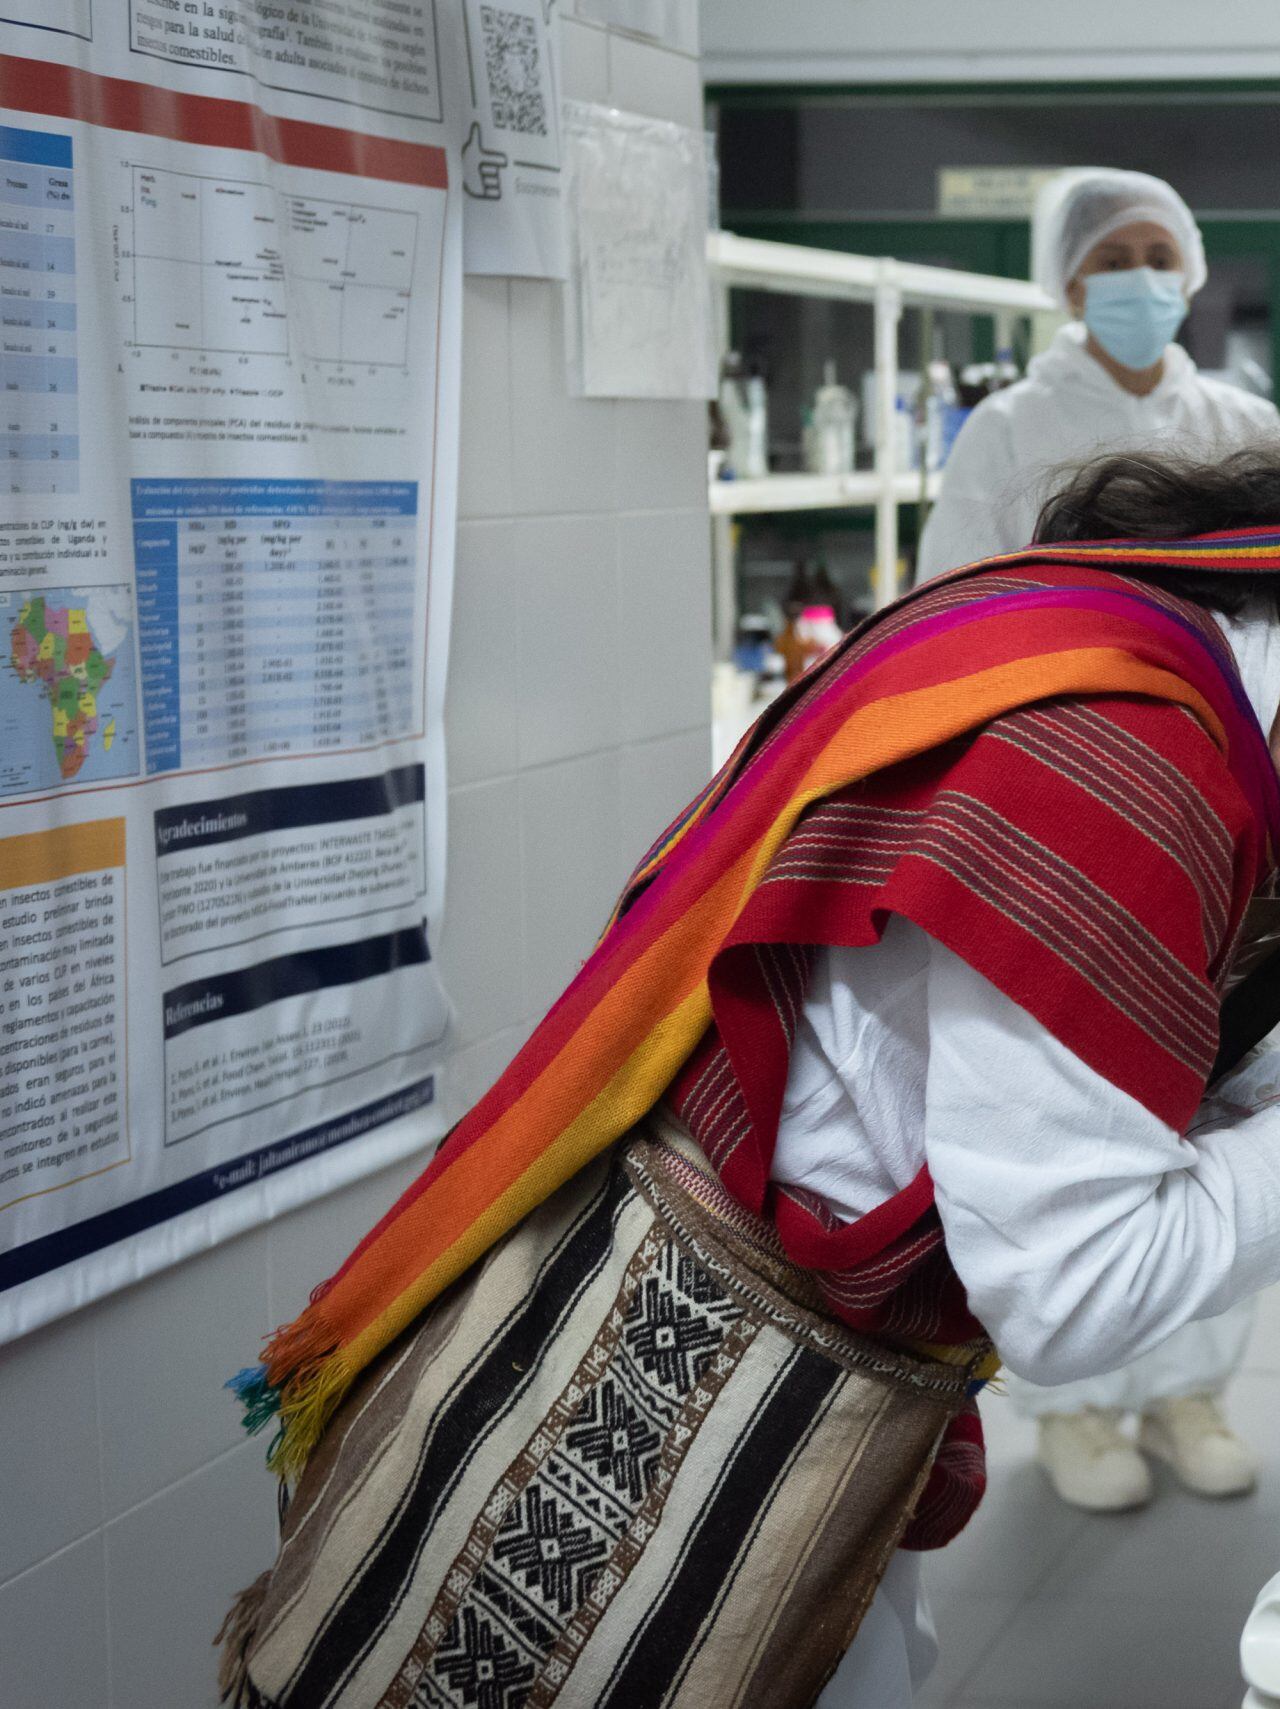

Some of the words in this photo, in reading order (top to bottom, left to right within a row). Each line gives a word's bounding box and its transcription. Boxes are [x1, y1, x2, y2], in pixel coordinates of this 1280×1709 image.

[184, 2, 198, 14] en
[203, 2, 214, 17] la
[164, 21, 185, 35] para
[189, 21, 199, 37] la
[203, 26, 235, 43] salud
[169, 44, 237, 65] comestibles.
[11, 888, 50, 907] insectos
[101, 873, 113, 887] de
[2, 911, 37, 930] estudio
[85, 894, 113, 910] brinda
[12, 930, 52, 948] insectos
[102, 914, 114, 927] de
[79, 933, 114, 951] limitada
[4, 978, 14, 992] de
[19, 972, 49, 988] varios
[85, 953, 114, 970] niveles
[9, 999, 20, 1012] en
[27, 993, 43, 1007] los
[73, 980, 86, 994] del
[165, 992, 225, 1026] Referencias
[2, 1009, 59, 1035] reglamentos
[104, 1011, 115, 1024] de
[4, 1052, 57, 1077] disponibles
[26, 1073, 50, 1090] eran
[54, 1062, 85, 1085] seguros
[88, 1056, 105, 1073] para
[15, 1094, 46, 1114] indicó
[3, 1134, 52, 1160] monitoreo
[57, 1128, 68, 1143] de
[22, 1160, 33, 1174] se
[36, 1147, 75, 1168] integren
